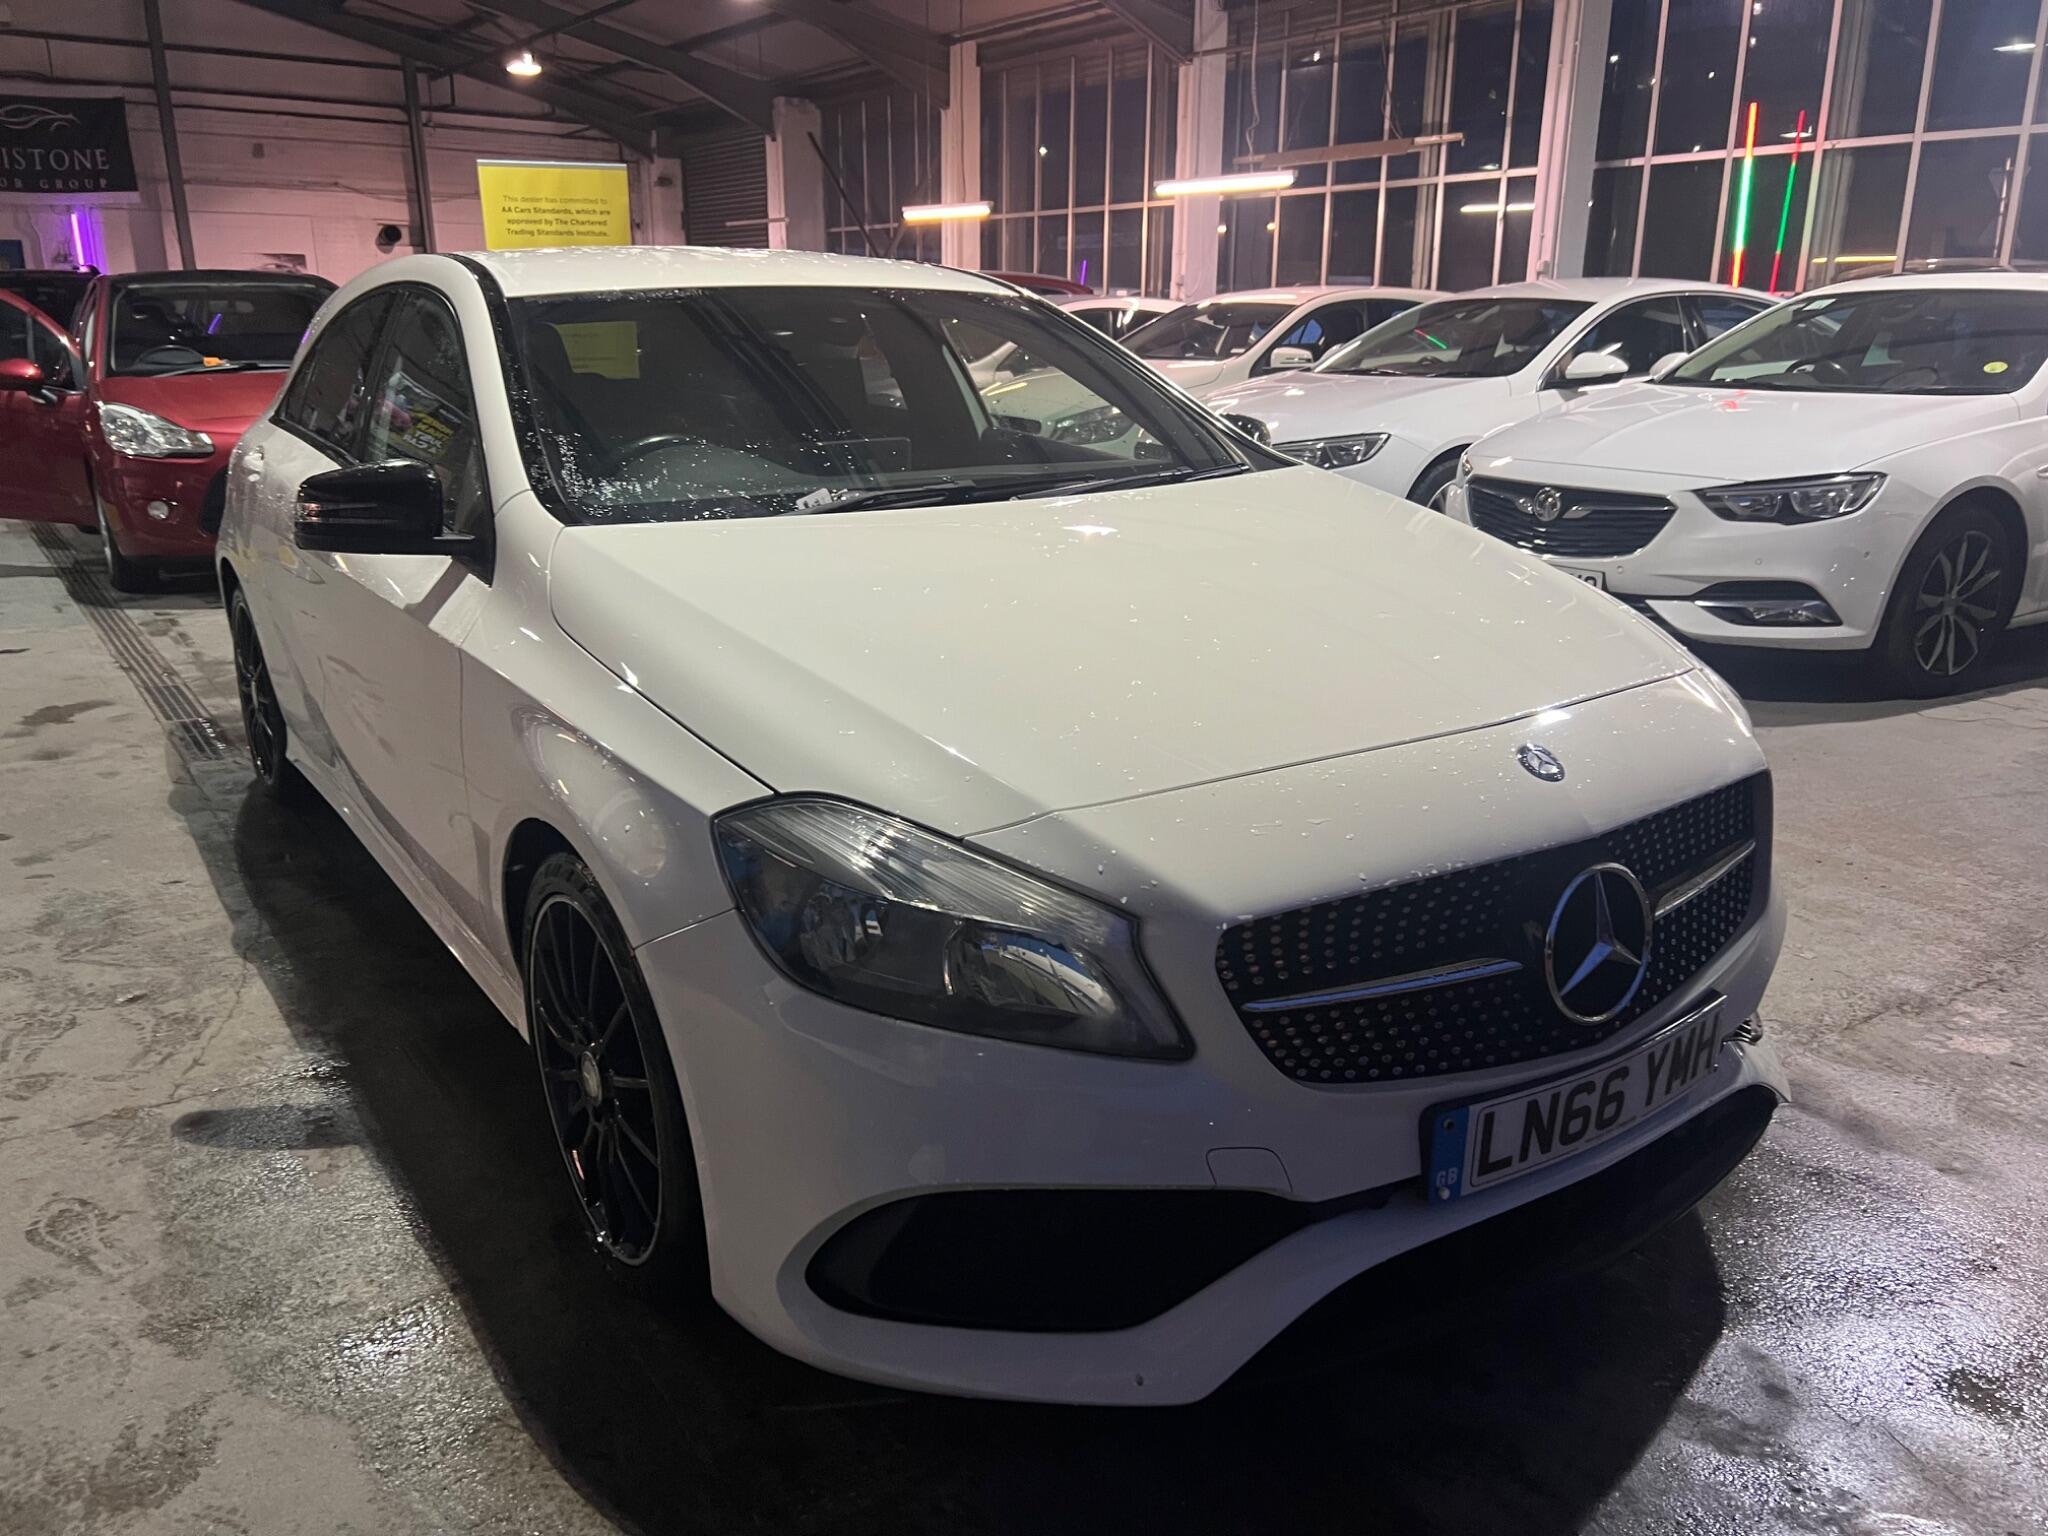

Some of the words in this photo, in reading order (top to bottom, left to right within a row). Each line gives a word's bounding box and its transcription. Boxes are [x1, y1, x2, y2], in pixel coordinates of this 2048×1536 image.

[39, 178, 108, 189] GROUP
[503, 194, 519, 202] This
[514, 206, 532, 214] Cars
[533, 207, 574, 215] Standards,
[575, 208, 598, 216] which
[507, 218, 543, 226] approved
[544, 218, 553, 227] by
[554, 218, 569, 226] The
[570, 218, 608, 227] Chartered
[506, 228, 535, 237] Trading
[536, 229, 574, 237] Standards
[1477, 1066, 1630, 1178] LN66
[1645, 1013, 1720, 1107] YMH
[1436, 1167, 1458, 1187] GB
